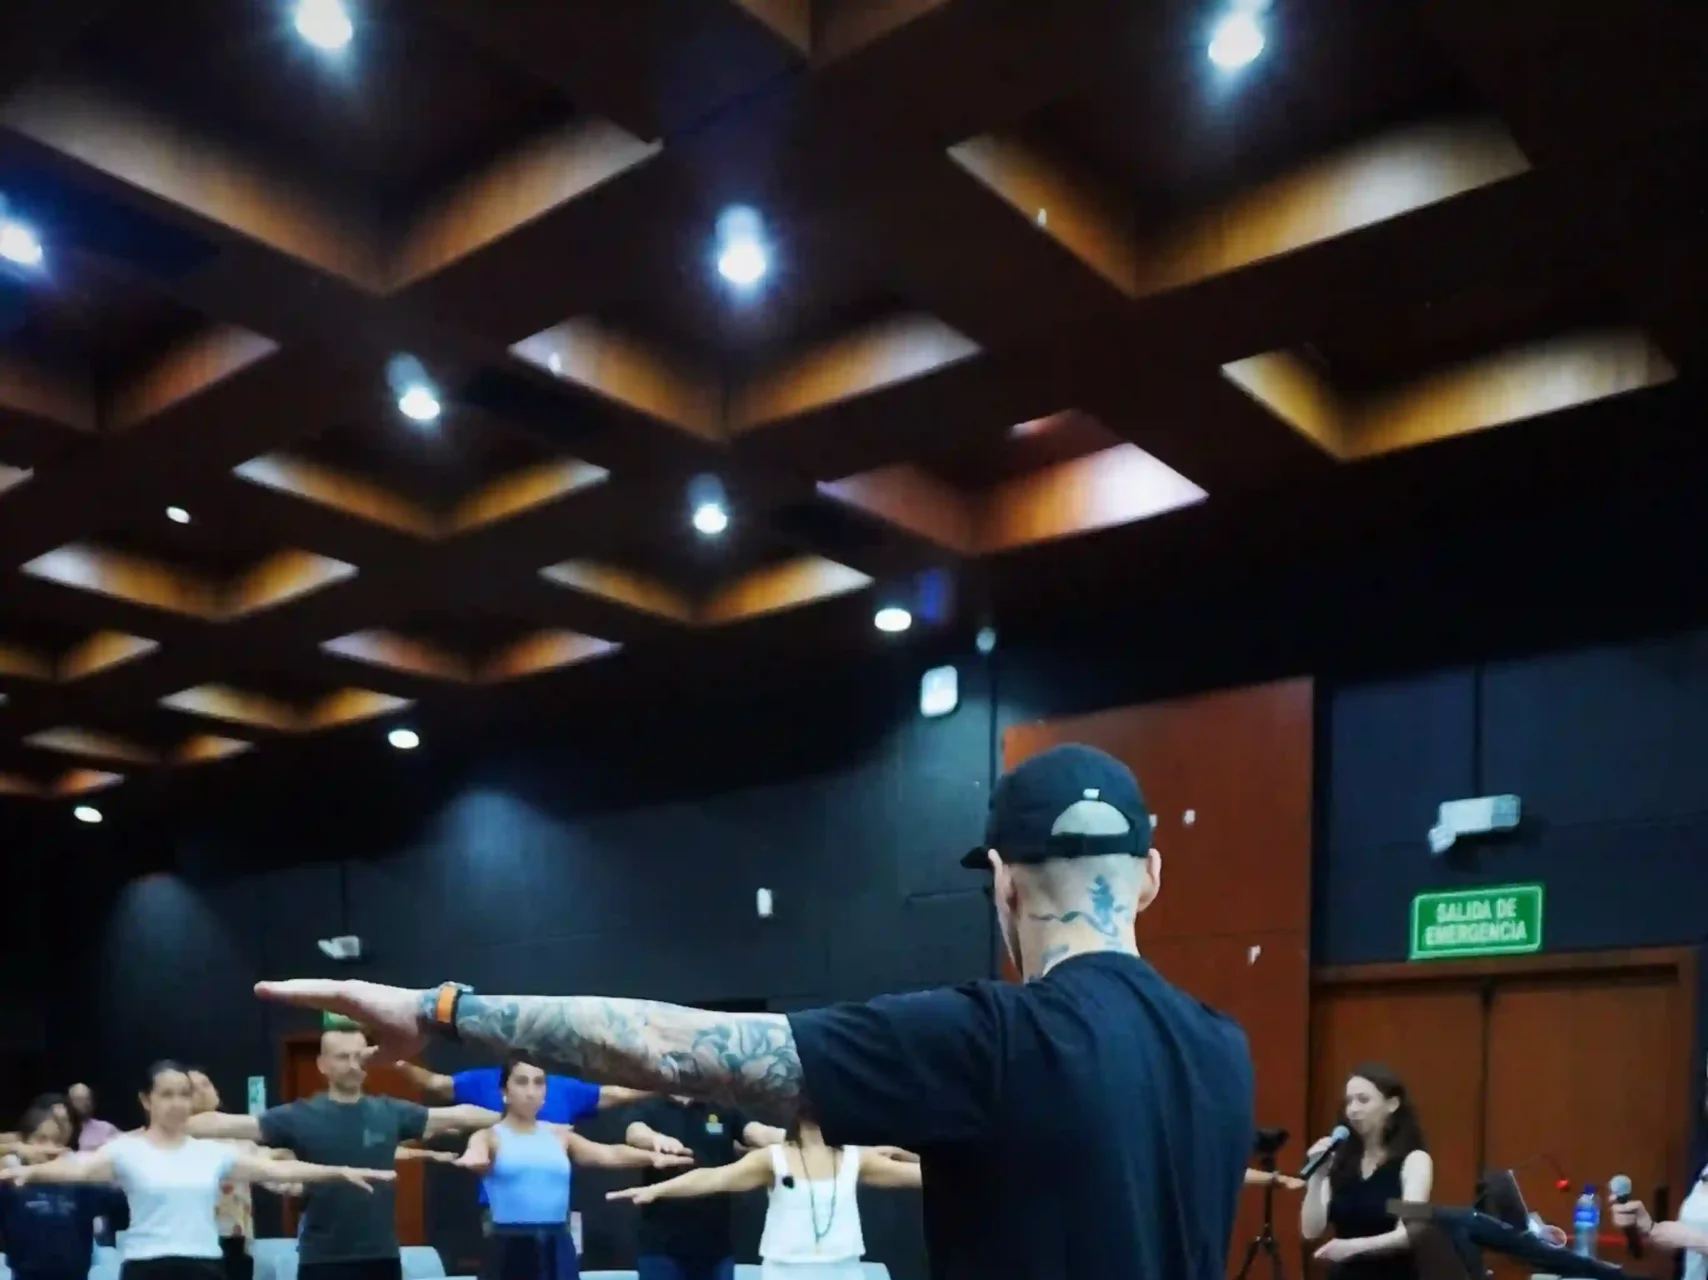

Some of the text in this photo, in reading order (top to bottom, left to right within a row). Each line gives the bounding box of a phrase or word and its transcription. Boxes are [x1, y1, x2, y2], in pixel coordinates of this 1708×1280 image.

[1436, 897, 1517, 923] SALIDA DE
[1425, 920, 1528, 946] EMERGENCIA
